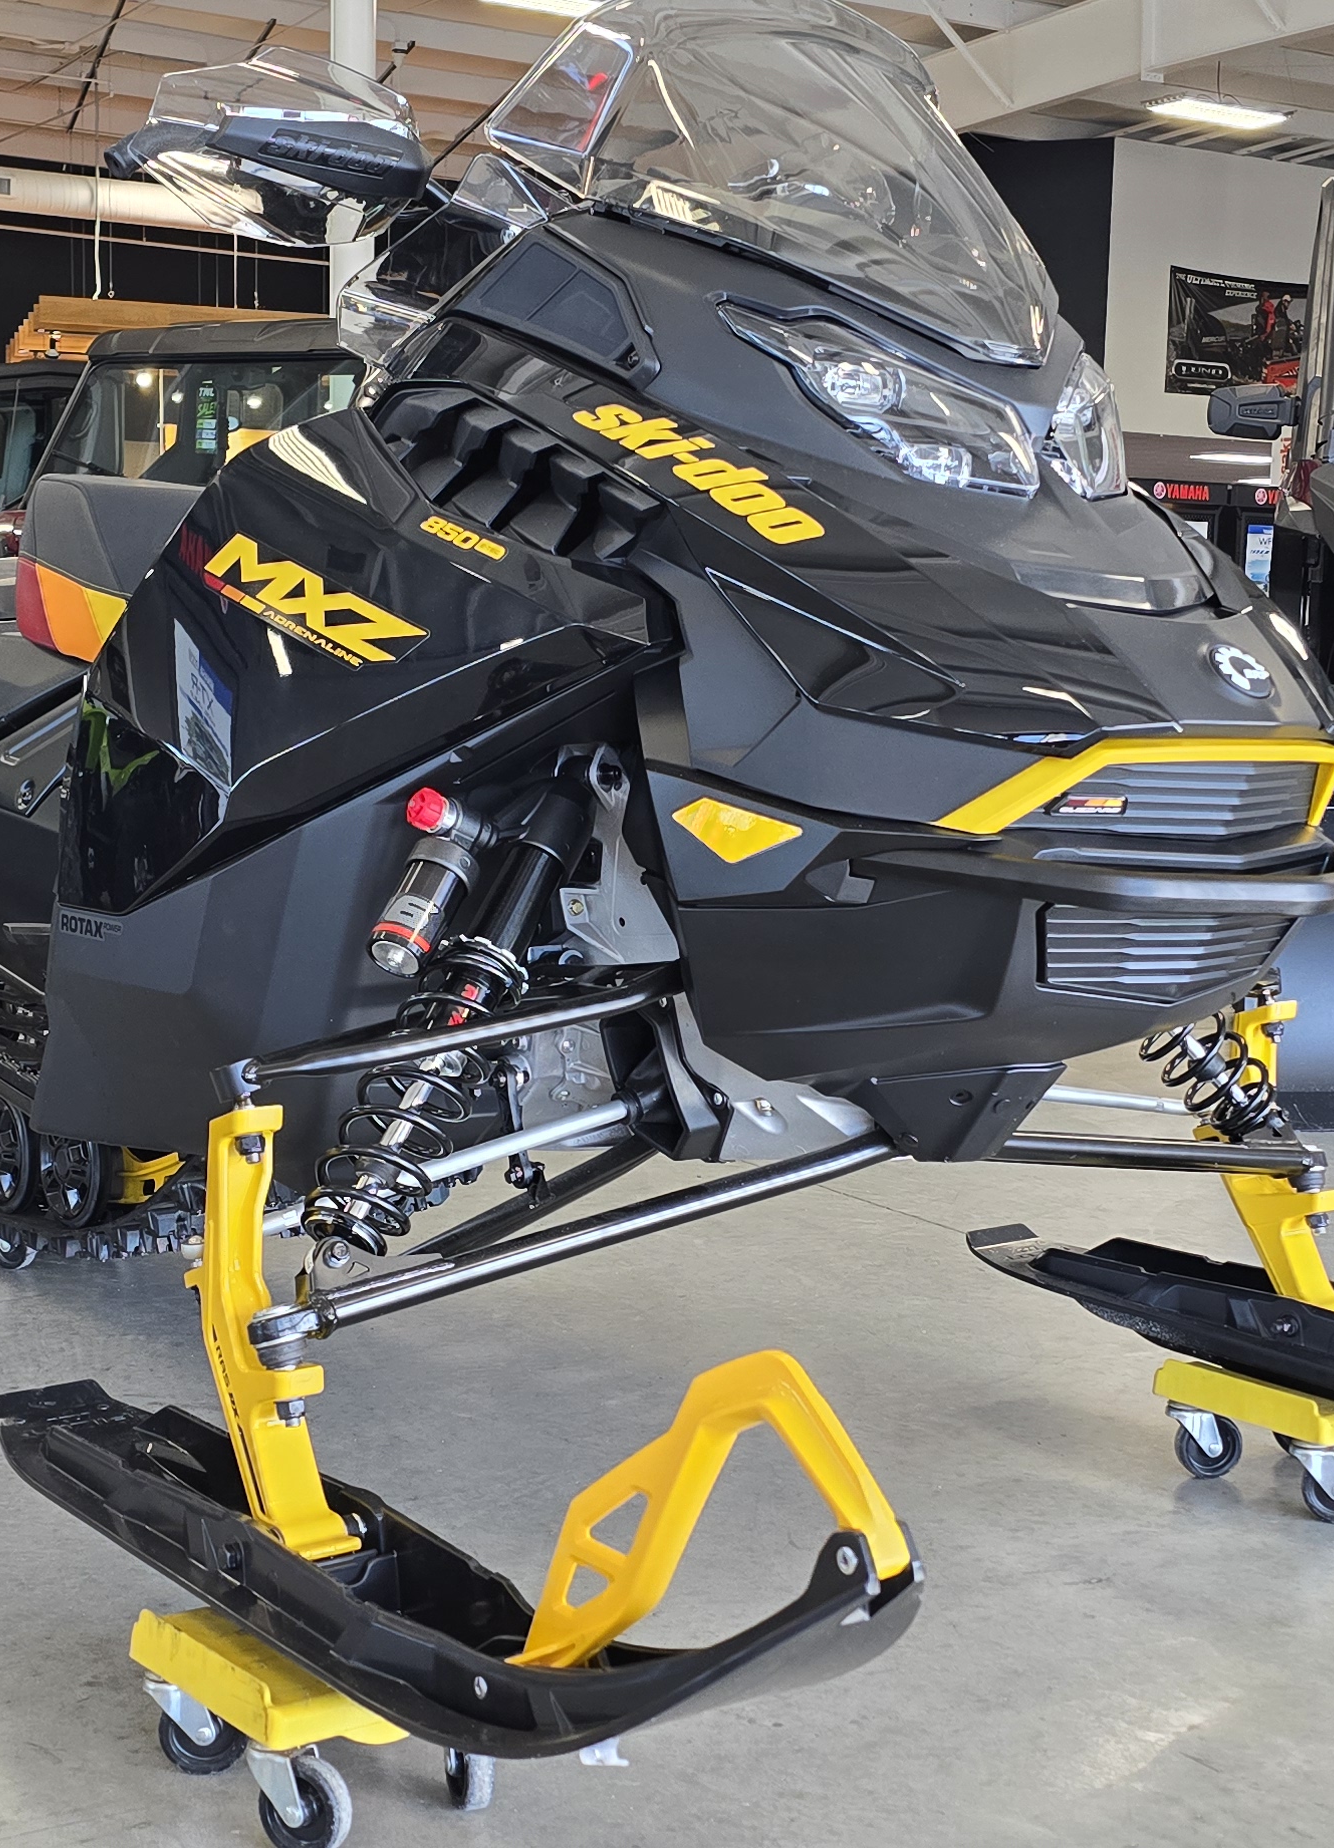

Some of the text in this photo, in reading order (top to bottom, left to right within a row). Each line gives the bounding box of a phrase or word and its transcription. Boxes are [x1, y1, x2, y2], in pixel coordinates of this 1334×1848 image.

[267, 134, 400, 175] ski-doo
[1180, 364, 1223, 380] LUND
[572, 403, 825, 545] ski-doo
[1166, 483, 1210, 502] YAMAHA
[419, 515, 480, 550] 850
[203, 533, 428, 662] MXZ
[263, 609, 364, 667] ADRENALINE
[60, 913, 104, 939] ROTAX
